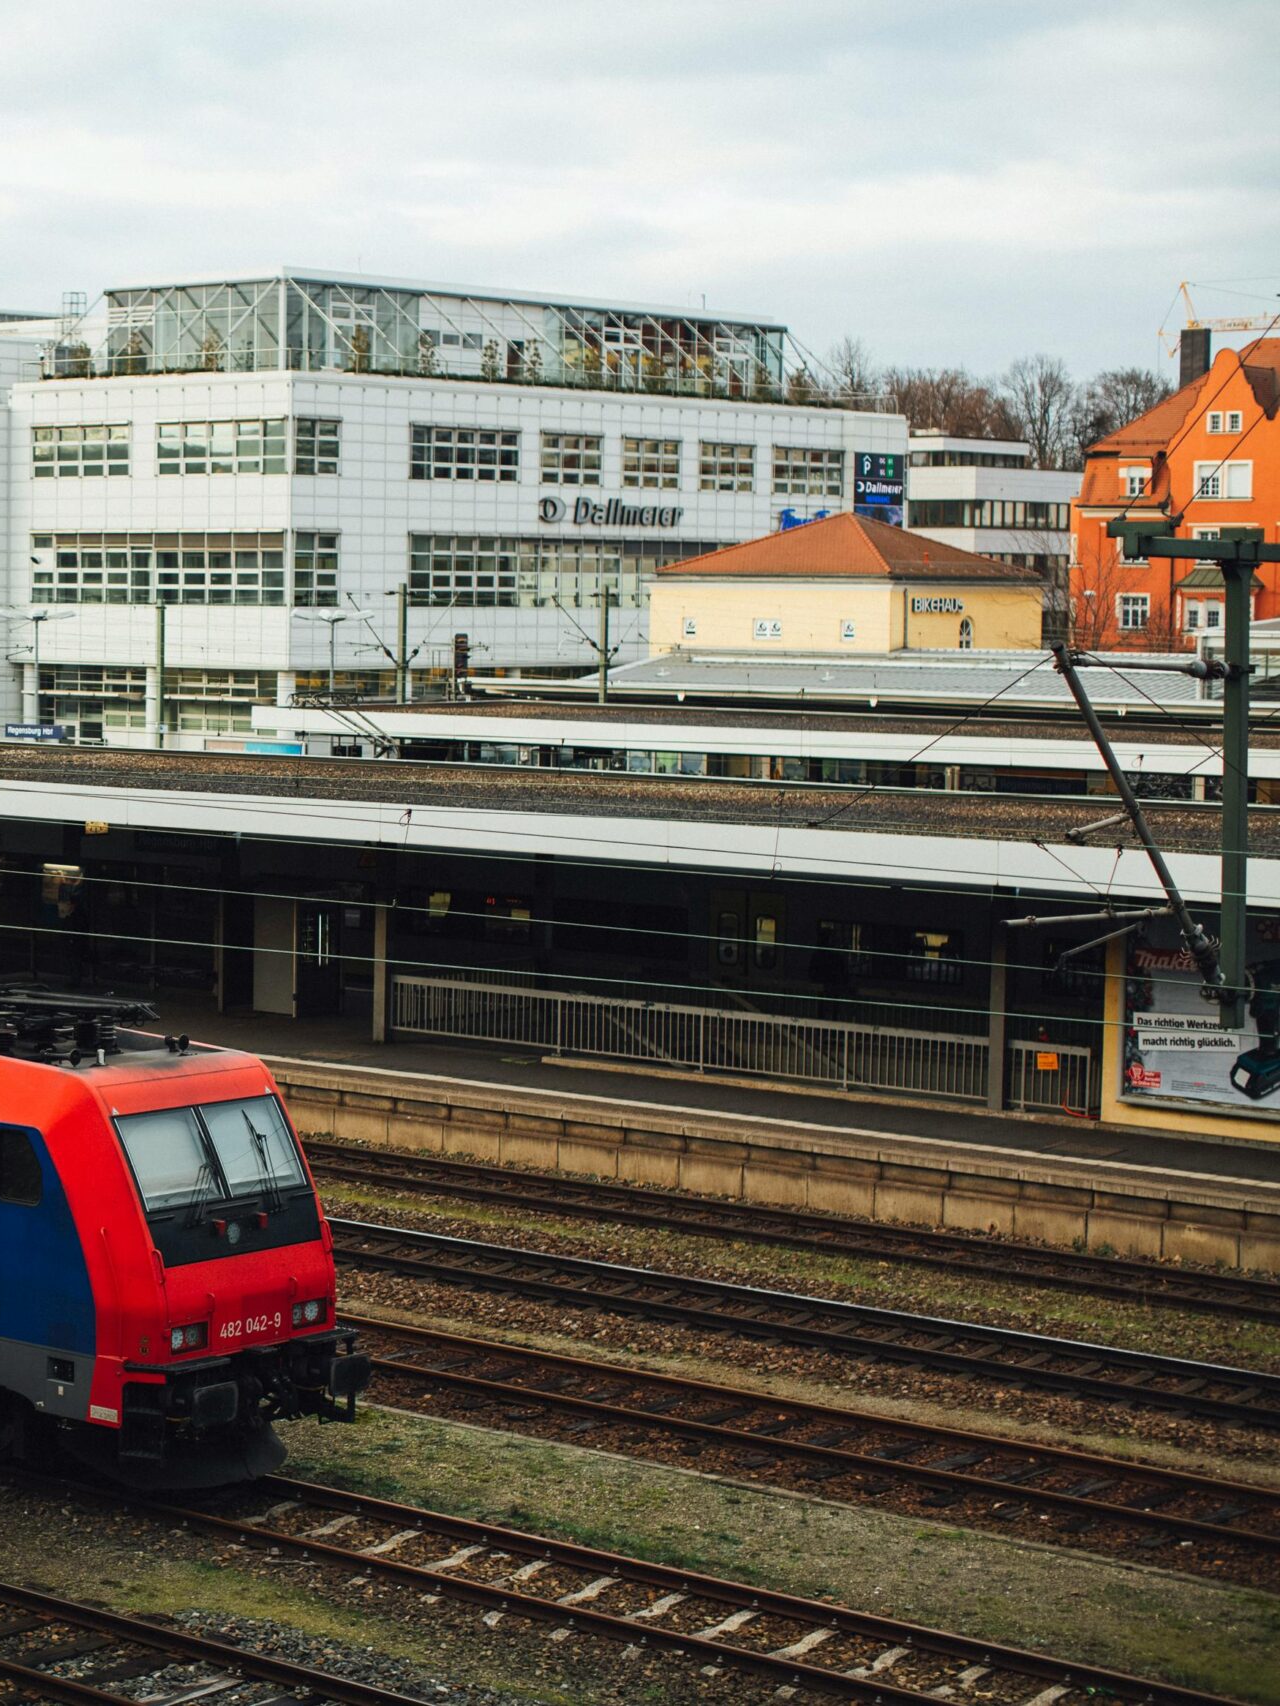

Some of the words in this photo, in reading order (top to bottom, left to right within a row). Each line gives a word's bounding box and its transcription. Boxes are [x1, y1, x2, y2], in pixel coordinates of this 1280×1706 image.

[575, 497, 684, 527] Dallmeier
[911, 597, 964, 613] BIKEHAUS
[1137, 1017, 1152, 1025] Das
[1154, 1018, 1185, 1029] richtige
[1142, 1037, 1168, 1046] macht
[1170, 1037, 1195, 1048] richtig
[1197, 1038, 1236, 1048] glücklich.
[220, 1320, 242, 1338] 482
[246, 1312, 281, 1333] 042-9
